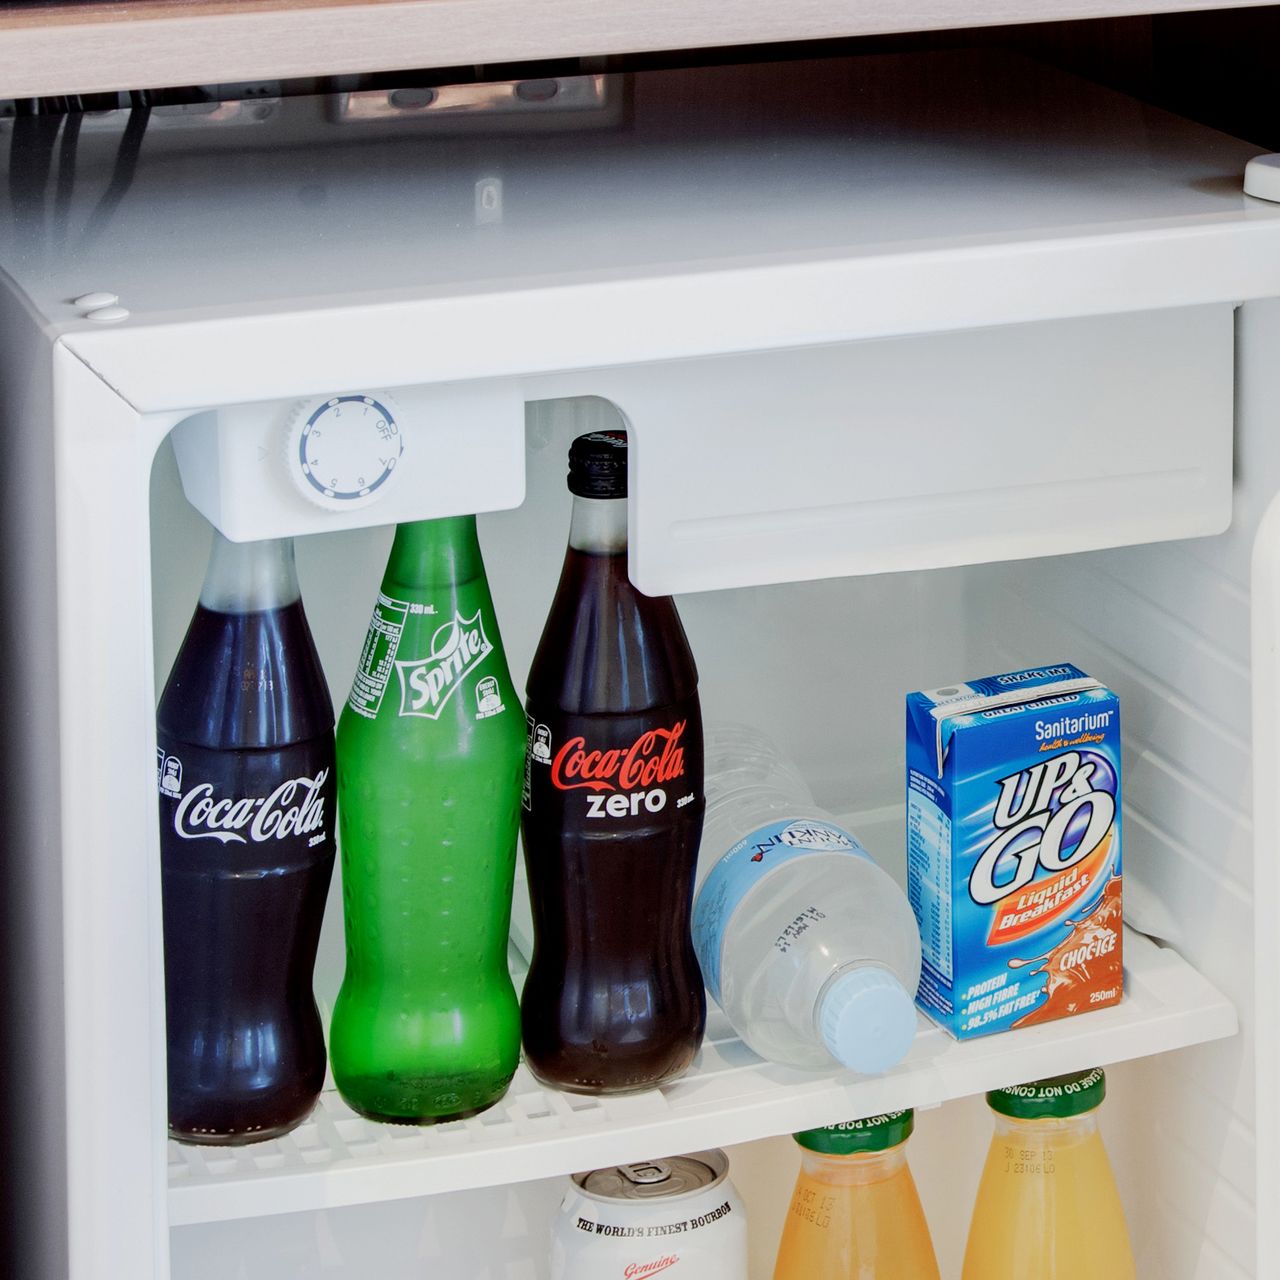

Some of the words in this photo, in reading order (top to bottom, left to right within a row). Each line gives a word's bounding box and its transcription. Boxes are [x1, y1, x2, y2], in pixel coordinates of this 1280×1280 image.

[334, 407, 341, 417] 2
[362, 407, 368, 416] 1
[312, 430, 321, 438] 3
[375, 419, 392, 440] OFF
[409, 628, 481, 710] Sprite
[999, 670, 1045, 685] SHAKE
[1048, 667, 1070, 679] ME
[551, 719, 687, 792] Coca-Cola
[174, 767, 329, 844] Coca-Cola
[586, 789, 667, 818] zero
[969, 790, 1116, 905] GO
[1000, 873, 1089, 930] Breakfast
[1017, 868, 1079, 910] Liquid
[967, 973, 1008, 1000] PROTEIN
[967, 997, 993, 1016] HIGH
[992, 982, 1020, 1006] FIBRE
[1038, 1086, 1063, 1097] NOT
[1063, 1083, 1081, 1095] DO
[866, 1114, 889, 1128] NOT
[1020, 1150, 1036, 1160] SEP
[577, 1217, 593, 1233] THE
[647, 1222, 688, 1236] FINEST
[691, 1201, 732, 1230] BOURBON
